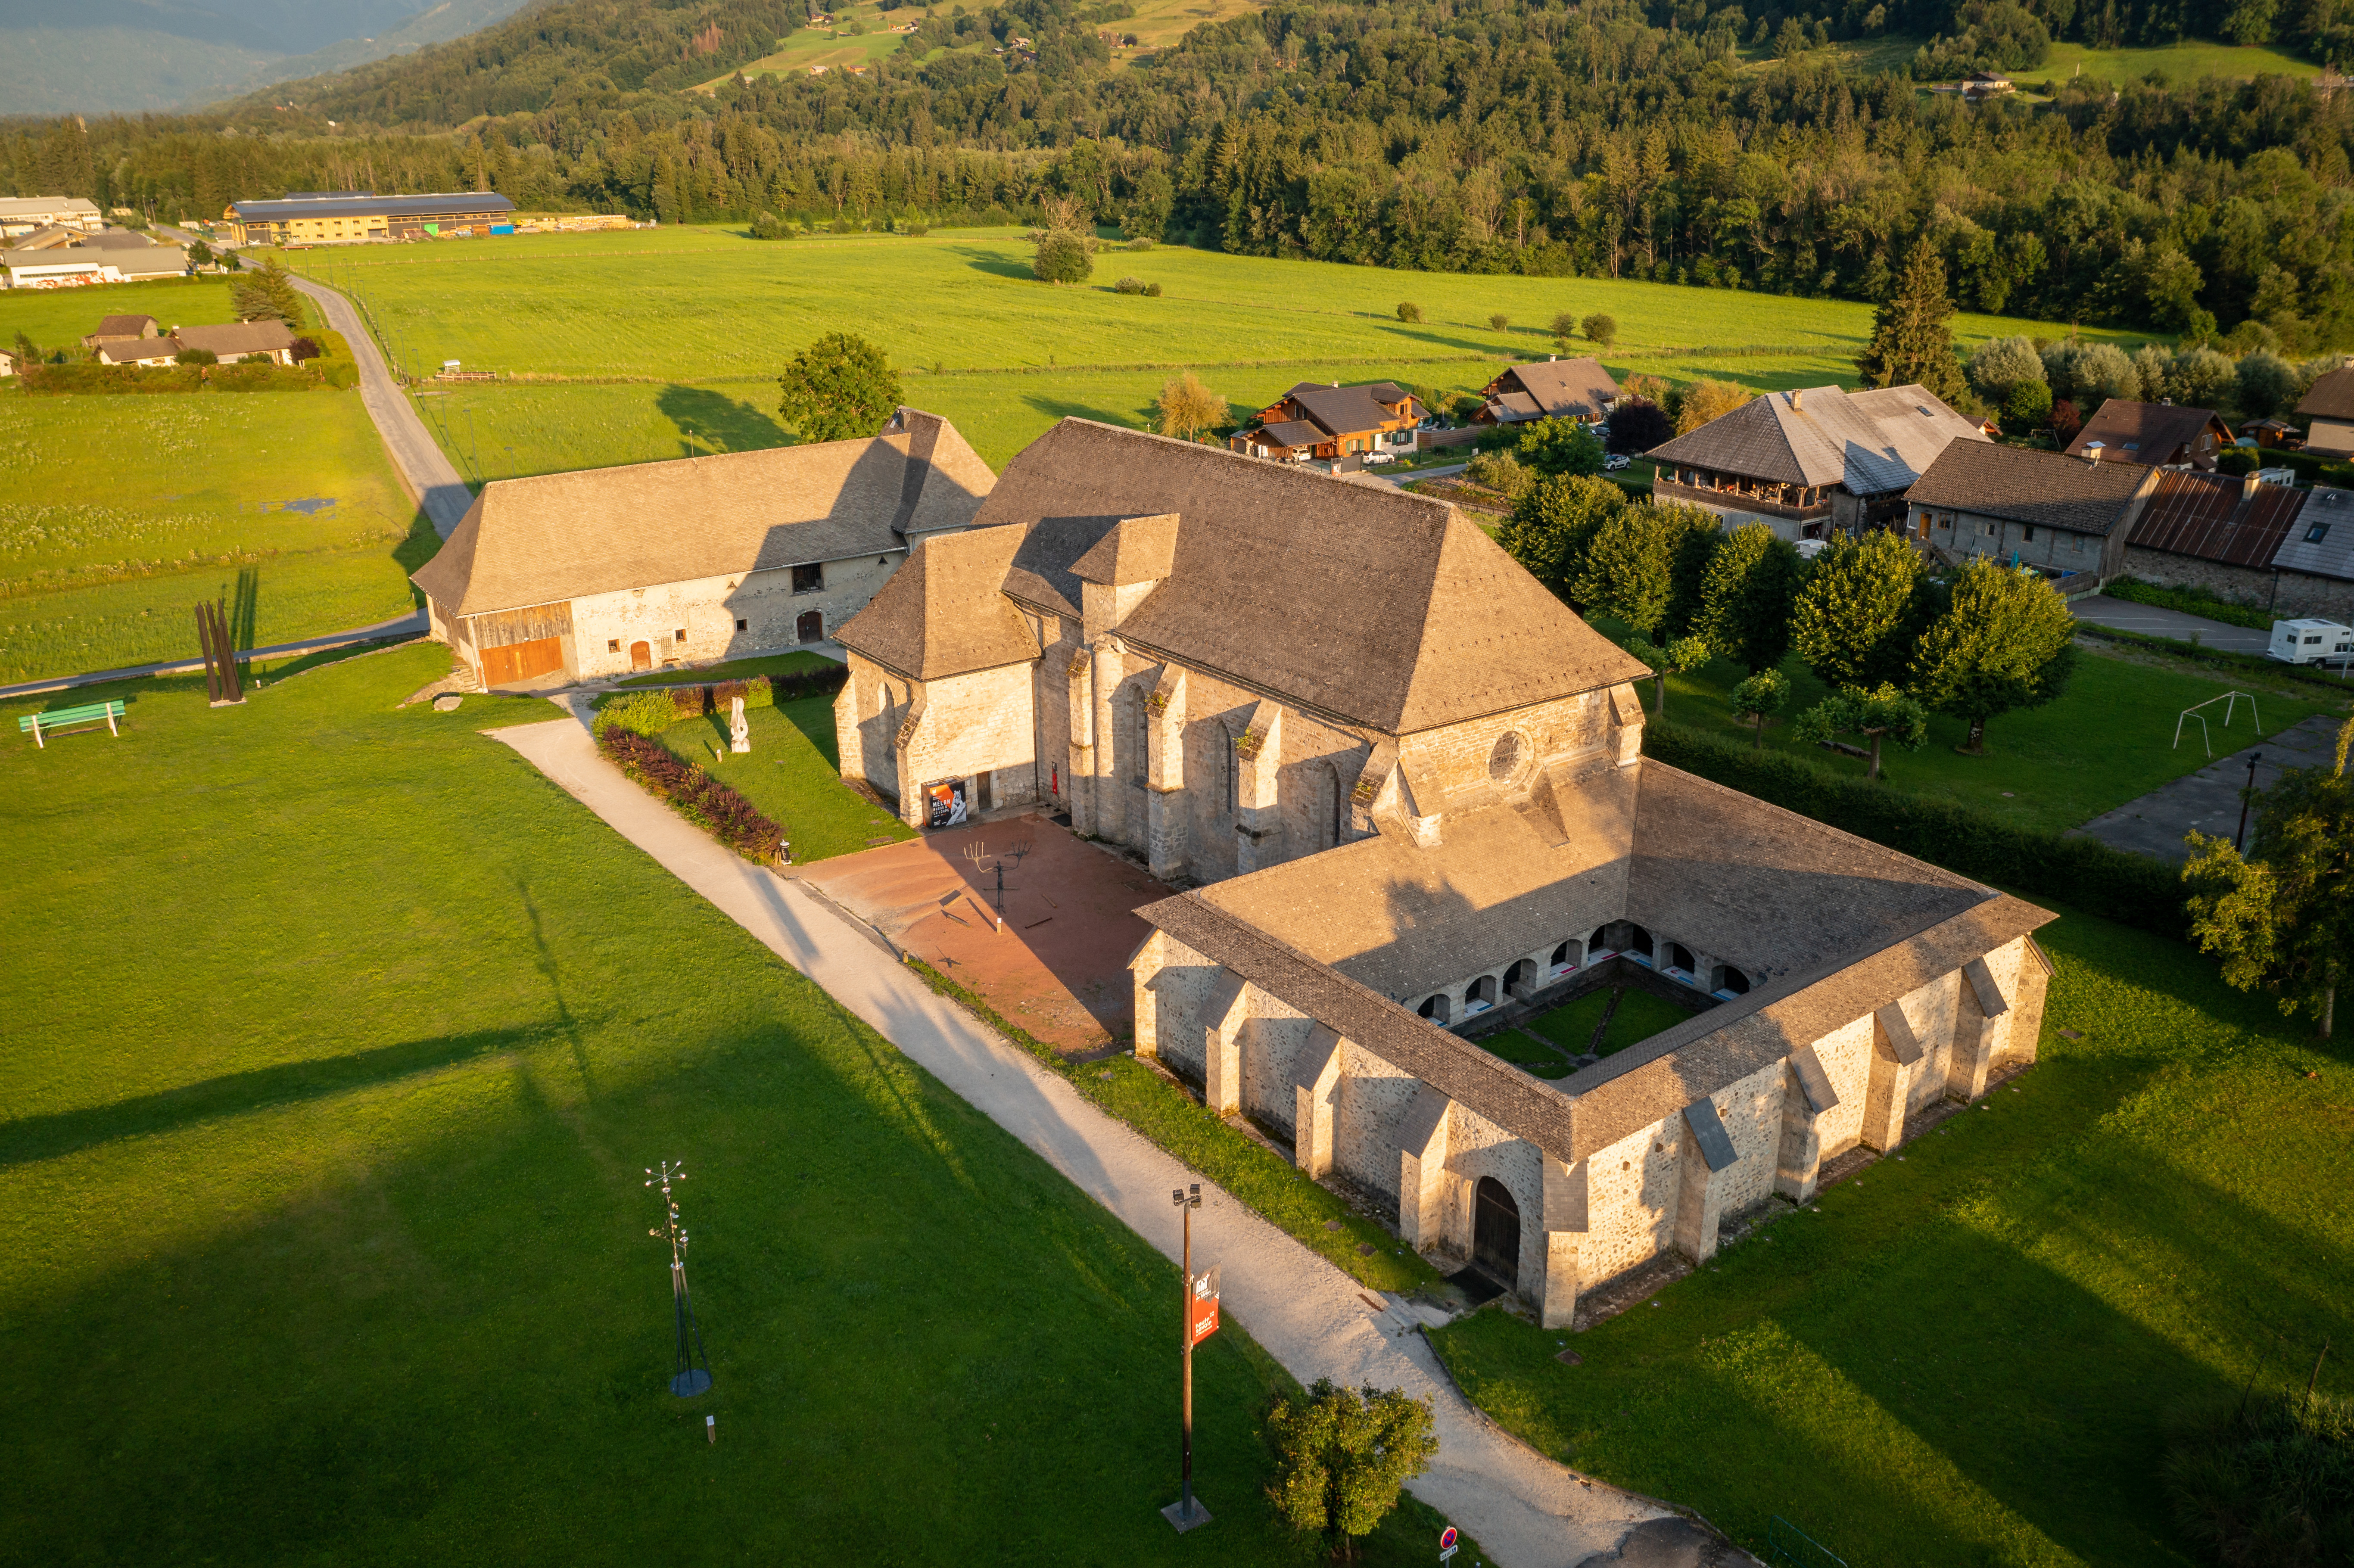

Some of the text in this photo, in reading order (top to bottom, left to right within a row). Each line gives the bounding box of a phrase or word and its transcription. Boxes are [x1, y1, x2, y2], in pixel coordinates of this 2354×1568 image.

[933, 799, 950, 808] MÉLAN
[1196, 1317, 1210, 1329] haute
[1196, 1320, 1212, 1334] savoie
[1442, 1550, 1451, 1559] SAUF
